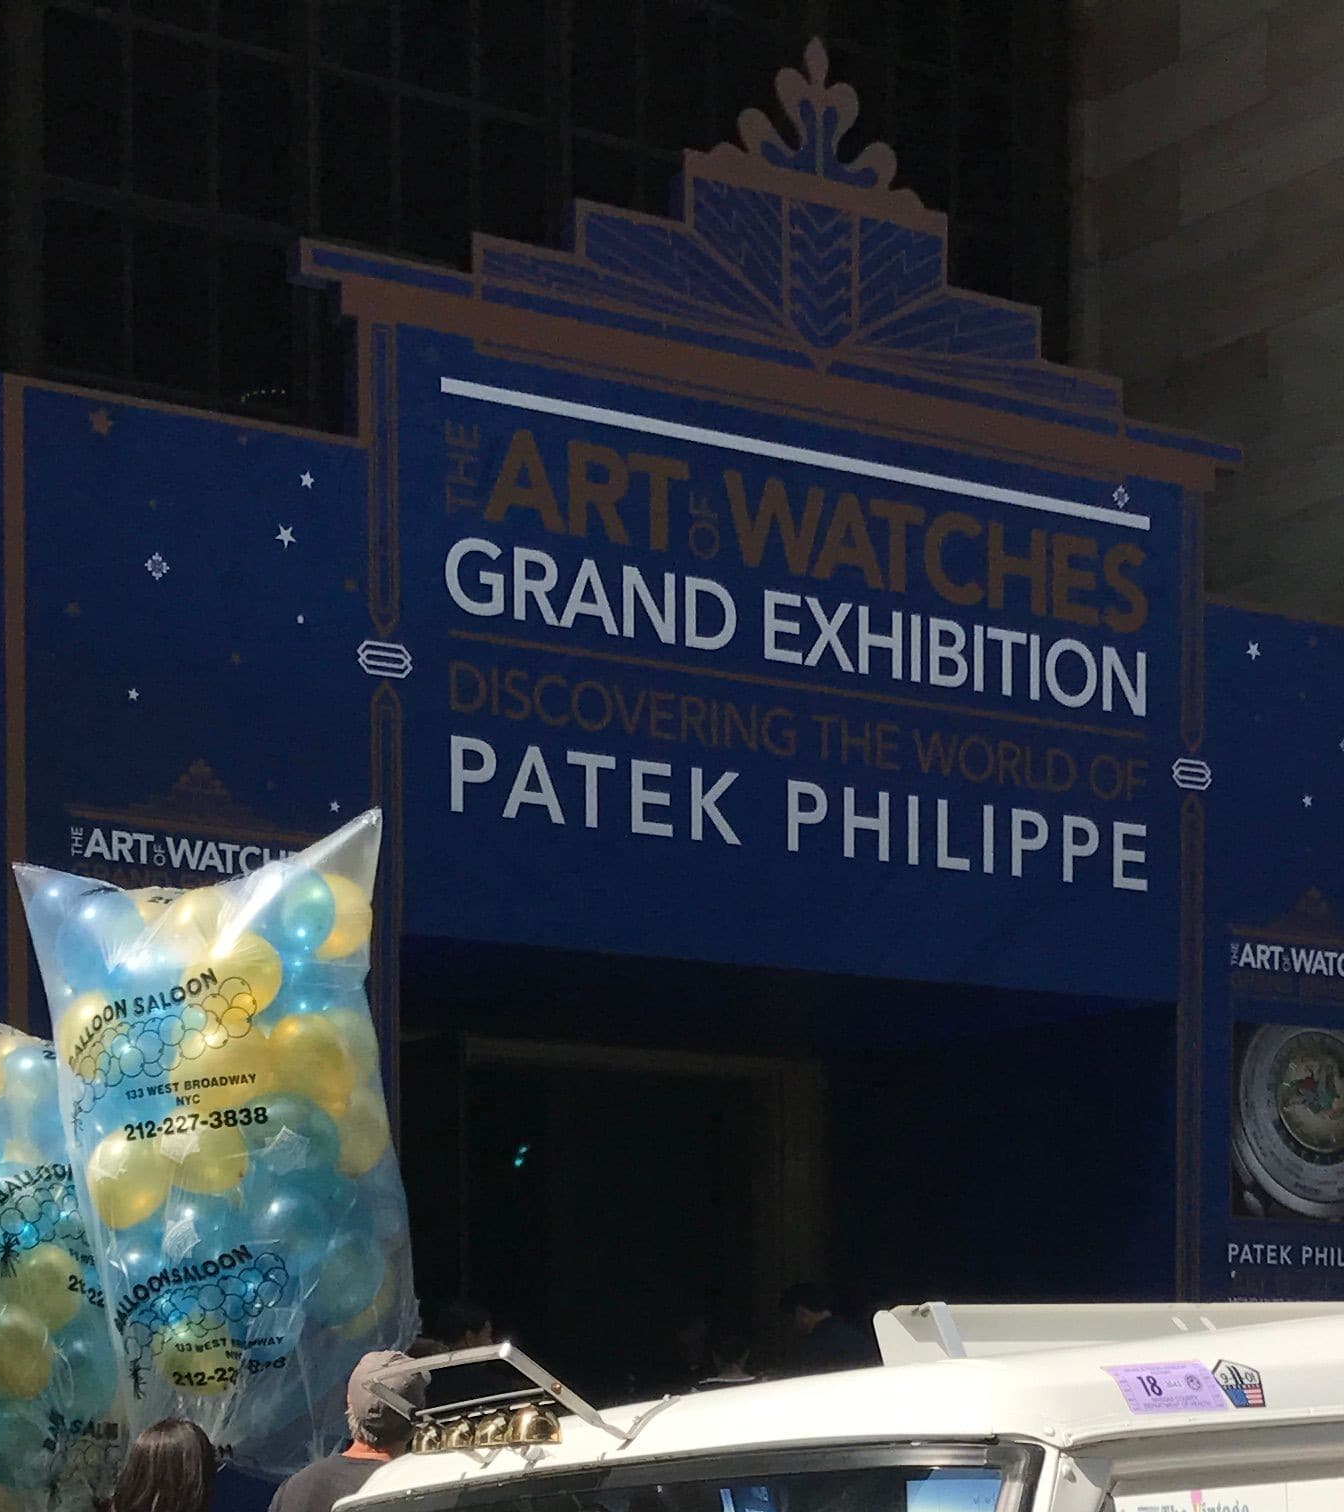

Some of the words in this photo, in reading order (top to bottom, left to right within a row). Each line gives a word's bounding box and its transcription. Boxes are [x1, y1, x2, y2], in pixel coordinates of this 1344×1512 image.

[445, 419, 479, 513] THE
[484, 429, 689, 551] ART
[689, 491, 719, 559] OF
[724, 470, 1148, 633] WATCHES
[445, 537, 737, 651] GRAND
[764, 590, 1146, 717] EXHIBITION
[449, 660, 797, 756] DISCOVERING
[812, 714, 900, 770] THE
[913, 729, 1076, 792] WORLD
[1090, 755, 1148, 801] OF
[450, 735, 742, 845] PATEK
[787, 779, 1148, 891] PHILIPPE
[71, 826, 83, 856] THE
[84, 828, 154, 865] ART
[1239, 943, 1284, 970] ART
[134, 967, 218, 1017] SALOON
[125, 1089, 144, 1101] 133
[147, 1082, 180, 1097] WEST
[184, 1073, 257, 1091] BROADWAY
[175, 1094, 200, 1106] NYC
[124, 1106, 269, 1141] 212-227-3838
[171, 1244, 253, 1284] SALOON
[1228, 1243, 1292, 1265] PATEK
[1137, 1376, 1163, 1397] 18
